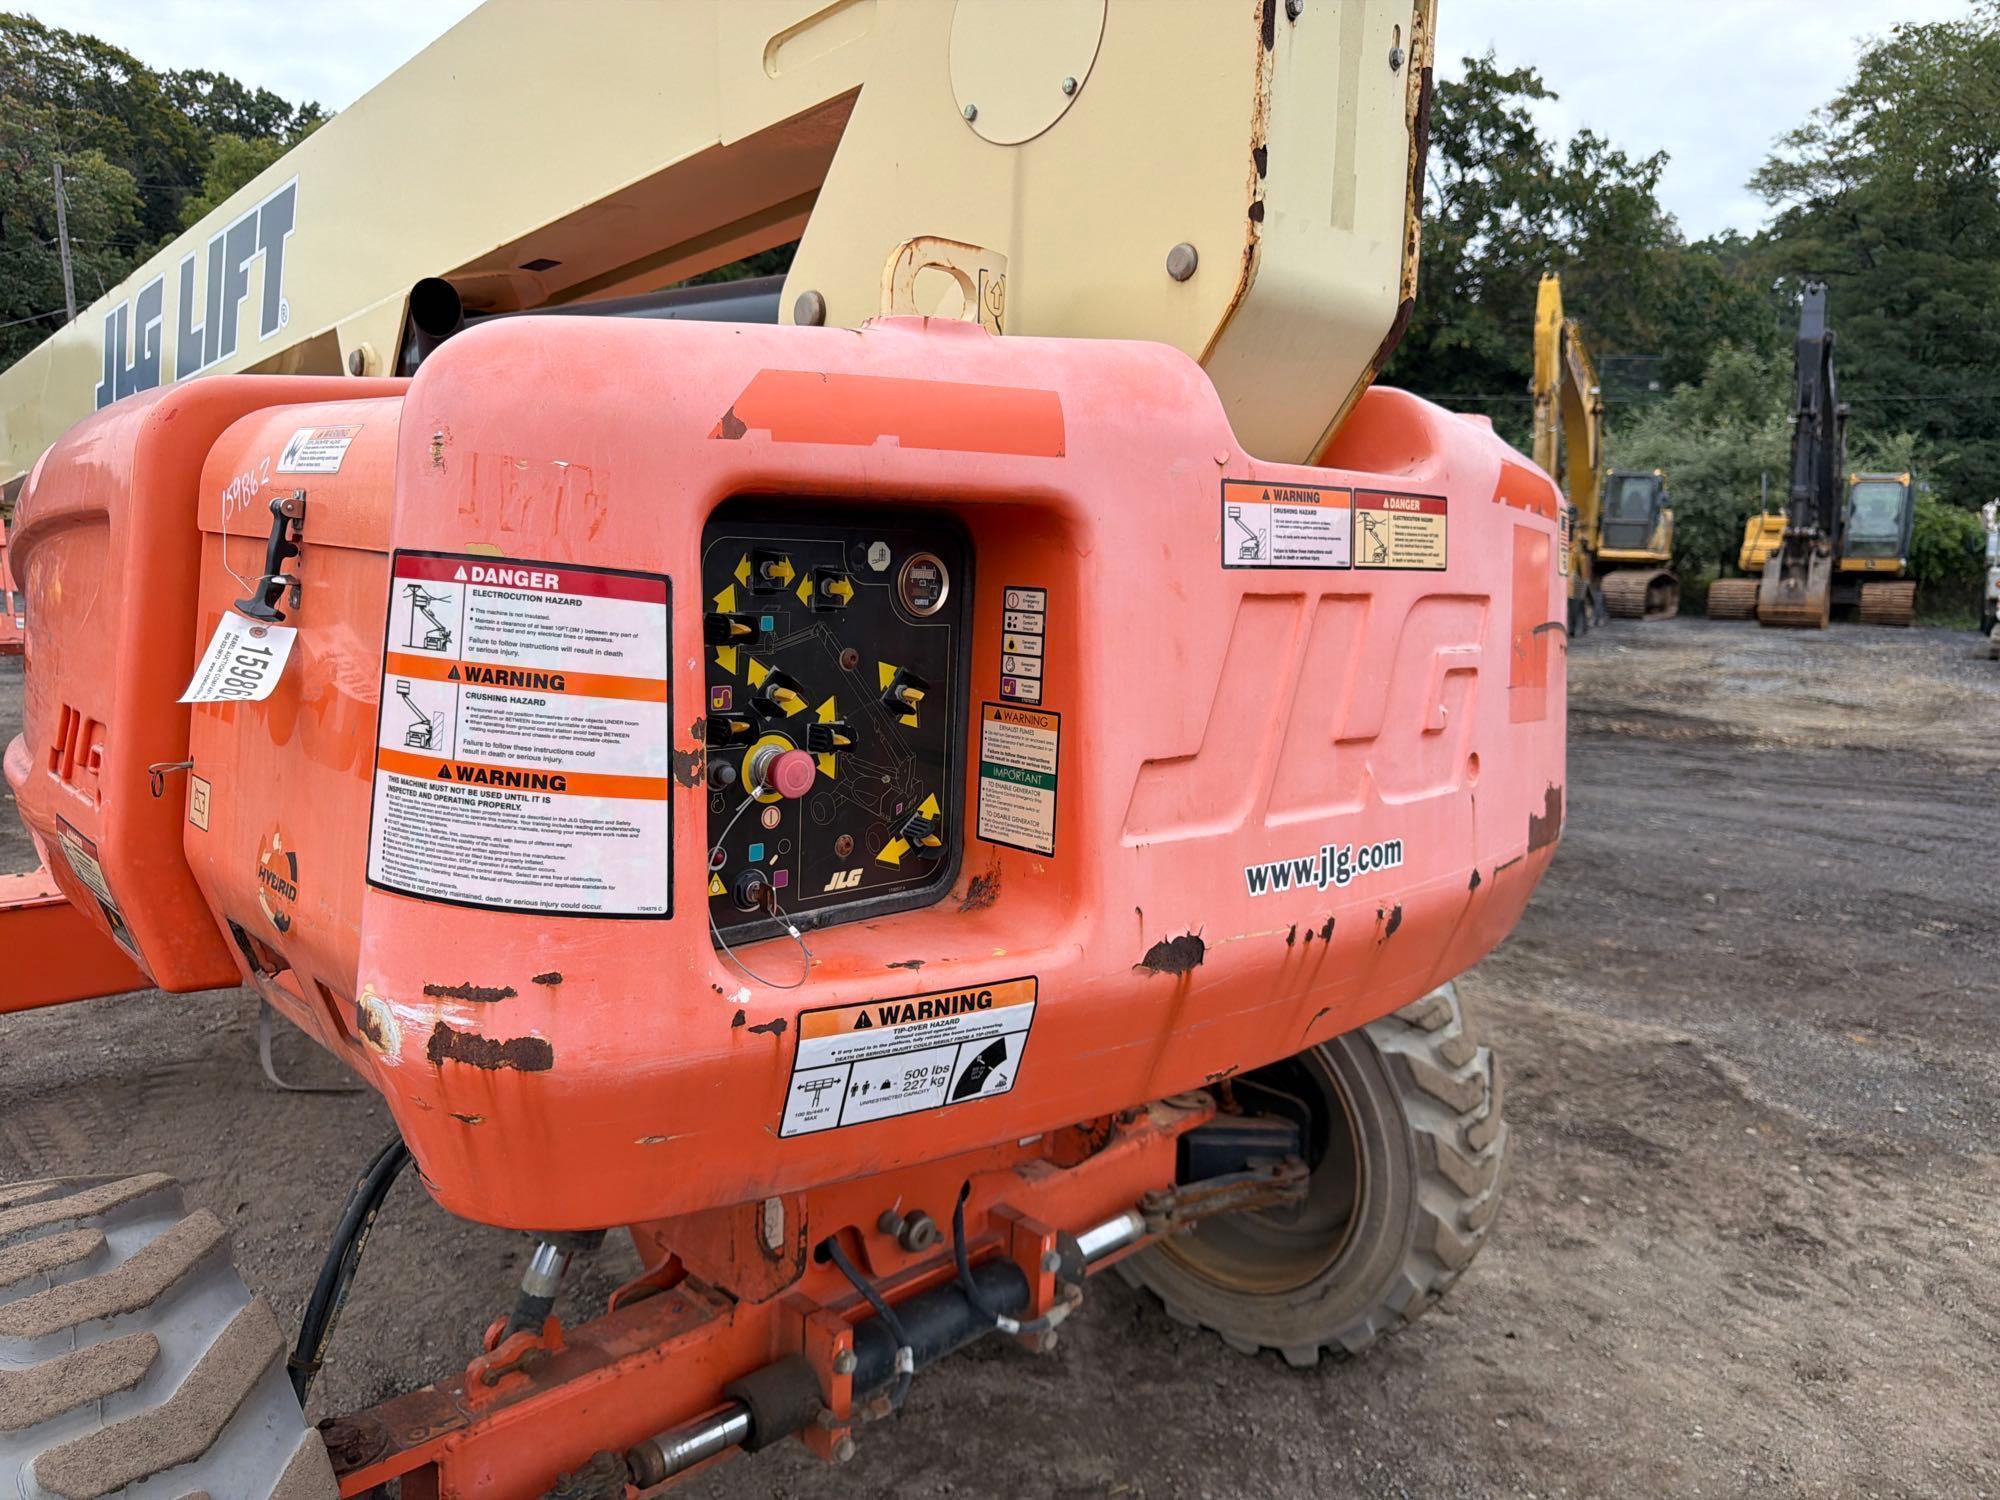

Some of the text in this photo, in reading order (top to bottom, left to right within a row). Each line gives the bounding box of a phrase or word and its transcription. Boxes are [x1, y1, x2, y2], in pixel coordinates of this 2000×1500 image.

[97, 273, 164, 410] JLG
[1274, 488, 1320, 504] WARNING
[1390, 497, 1420, 510] DANGER
[471, 566, 559, 589] DANGER
[472, 588, 582, 606] ELECTROCUTION HAZARD
[524, 612, 551, 620] insulated.
[500, 619, 526, 628] clearance
[584, 627, 608, 636] between
[620, 631, 631, 639] part
[537, 630, 562, 638] electrical
[584, 634, 613, 644] apparatus.
[468, 636, 489, 644] Failure
[498, 638, 517, 647] follow
[519, 641, 558, 651] instructions
[573, 646, 593, 654] result
[603, 649, 623, 657] death
[499, 648, 519, 657] injury.
[216, 649, 232, 672] AUCTION
[465, 665, 564, 691] WARNING
[465, 691, 546, 706] CRUSHING HAZARD
[1004, 709, 1048, 728] WARNING
[1120, 593, 1491, 848] JLG
[999, 724, 1034, 736] EXHAUST FUMES
[463, 738, 483, 747] Failure
[492, 741, 511, 750] follow
[513, 743, 532, 751] these
[533, 745, 573, 755] instructions
[575, 749, 595, 757] could
[487, 749, 506, 758] death
[516, 752, 541, 761] serious
[542, 755, 563, 765] injury.
[456, 766, 566, 791] WARNING
[993, 765, 1041, 785] IMPORTANT
[388, 774, 399, 784] THIS
[400, 777, 427, 789] MACHINE
[428, 782, 447, 792] MUST
[449, 785, 464, 795] NOT
[467, 788, 477, 796] BE
[479, 789, 502, 799] USED
[504, 792, 528, 802] UNTIL
[542, 796, 551, 804] IS
[388, 784, 522, 811] INSPECTED AND OPERATING PROPERLY.
[994, 782, 1011, 791] ENABLE
[1012, 785, 1040, 797] GENERATOR
[987, 809, 992, 817] TO
[992, 811, 1010, 821] DISABLE
[1011, 815, 1039, 827] GENERATOR
[1247, 838, 1403, 896] www.jlg.com
[823, 867, 864, 892] JLG
[392, 877, 410, 888] machine
[416, 883, 424, 891] not
[425, 885, 447, 897] properly
[449, 889, 482, 900] maintained,
[484, 894, 503, 902] death
[513, 897, 538, 906] serious
[539, 900, 558, 909] injury
[879, 989, 992, 1026] WARNING
[894, 1017, 960, 1034] TIP-OVER HAZARD
[835, 1054, 854, 1062] DEATH
[865, 1048, 890, 1057] SERIOUS
[891, 1044, 912, 1053] INJURY
[912, 1041, 932, 1049] COULD
[932, 1037, 954, 1046] RESULT
[953, 1034, 970, 1042] FROM
[974, 1028, 1000, 1039] TIP-OVER.
[904, 1063, 950, 1080] 500 lbs
[902, 1075, 945, 1091] 227 kg
[859, 1087, 931, 1106] UNRESTRICTED CAPACITY
